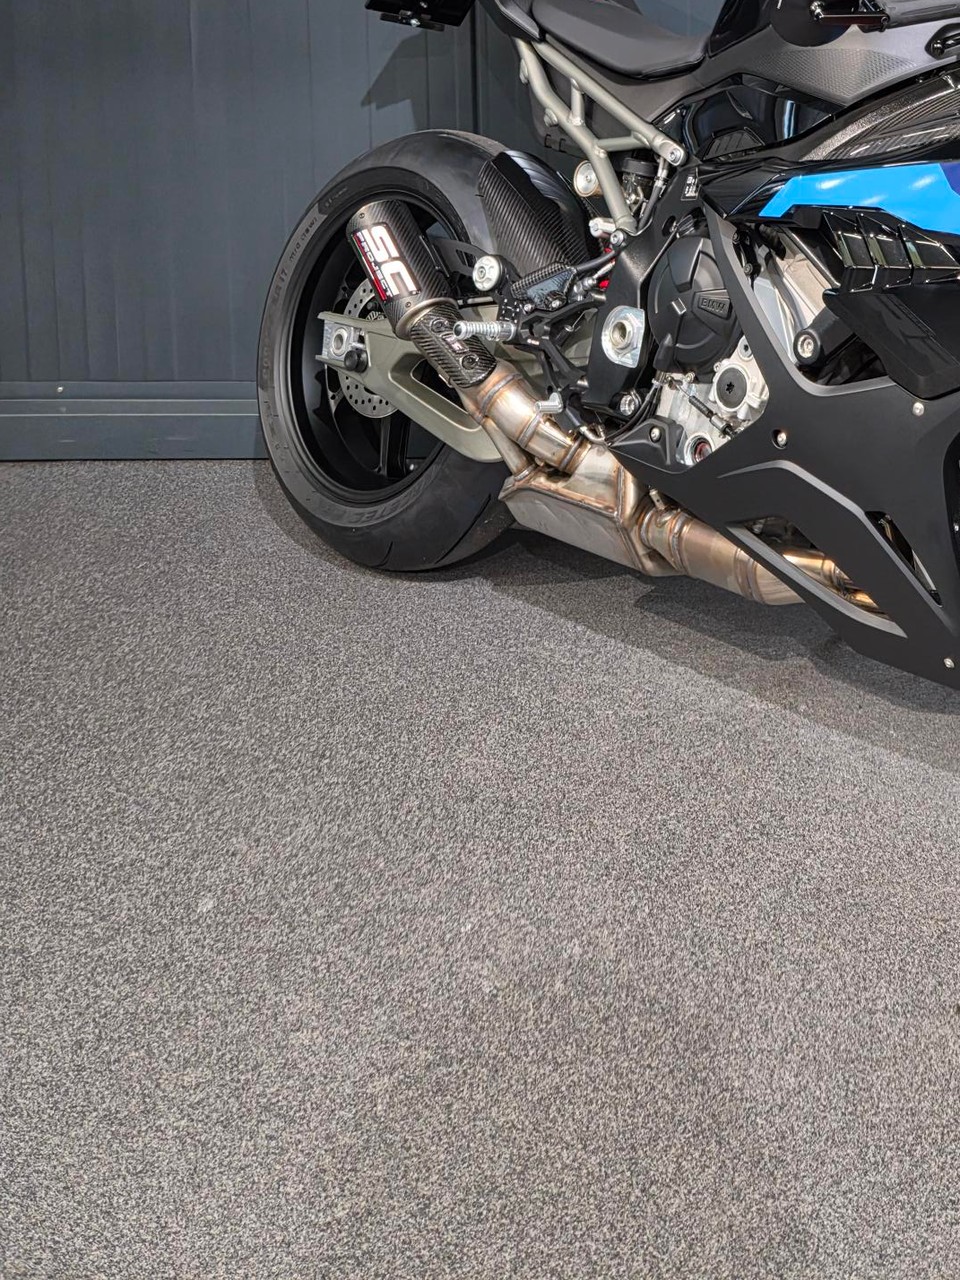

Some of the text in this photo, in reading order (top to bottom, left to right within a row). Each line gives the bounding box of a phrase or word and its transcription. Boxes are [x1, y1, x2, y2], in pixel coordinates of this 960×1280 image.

[356, 231, 393, 298] PROJECT
[361, 225, 418, 296] SC
[700, 297, 727, 312] BMW
